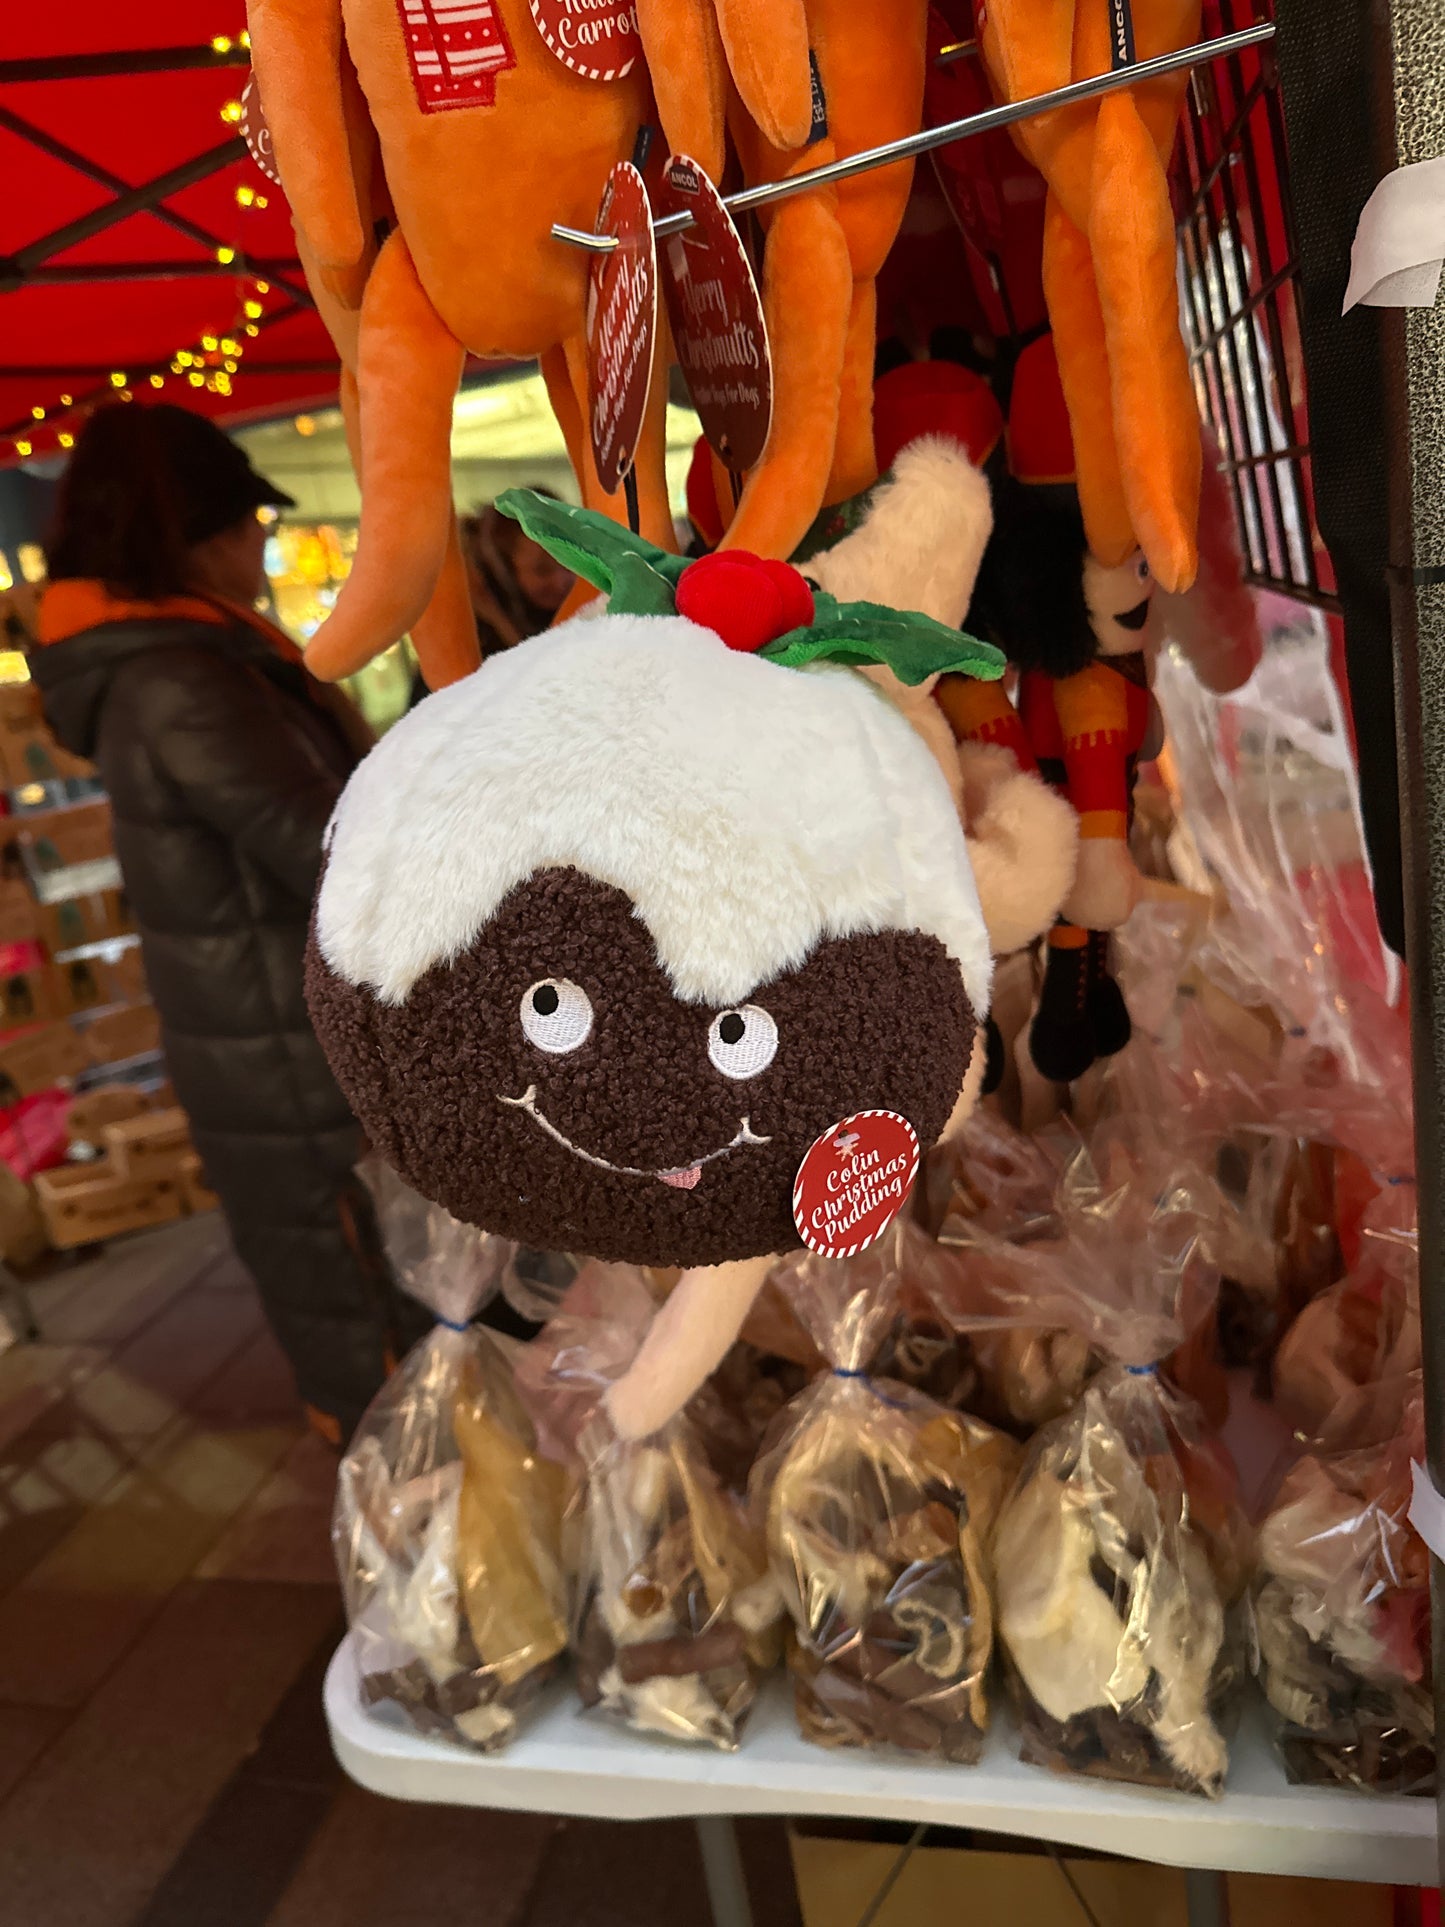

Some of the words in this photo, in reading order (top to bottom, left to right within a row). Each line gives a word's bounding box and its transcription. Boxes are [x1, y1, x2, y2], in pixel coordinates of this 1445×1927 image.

[558, 6, 640, 48] Carrot
[671, 171, 698, 188] ANCOL
[811, 1153, 907, 1229] Christmas
[826, 1149, 880, 1192] Colin
[825, 1176, 902, 1243] Pudding
